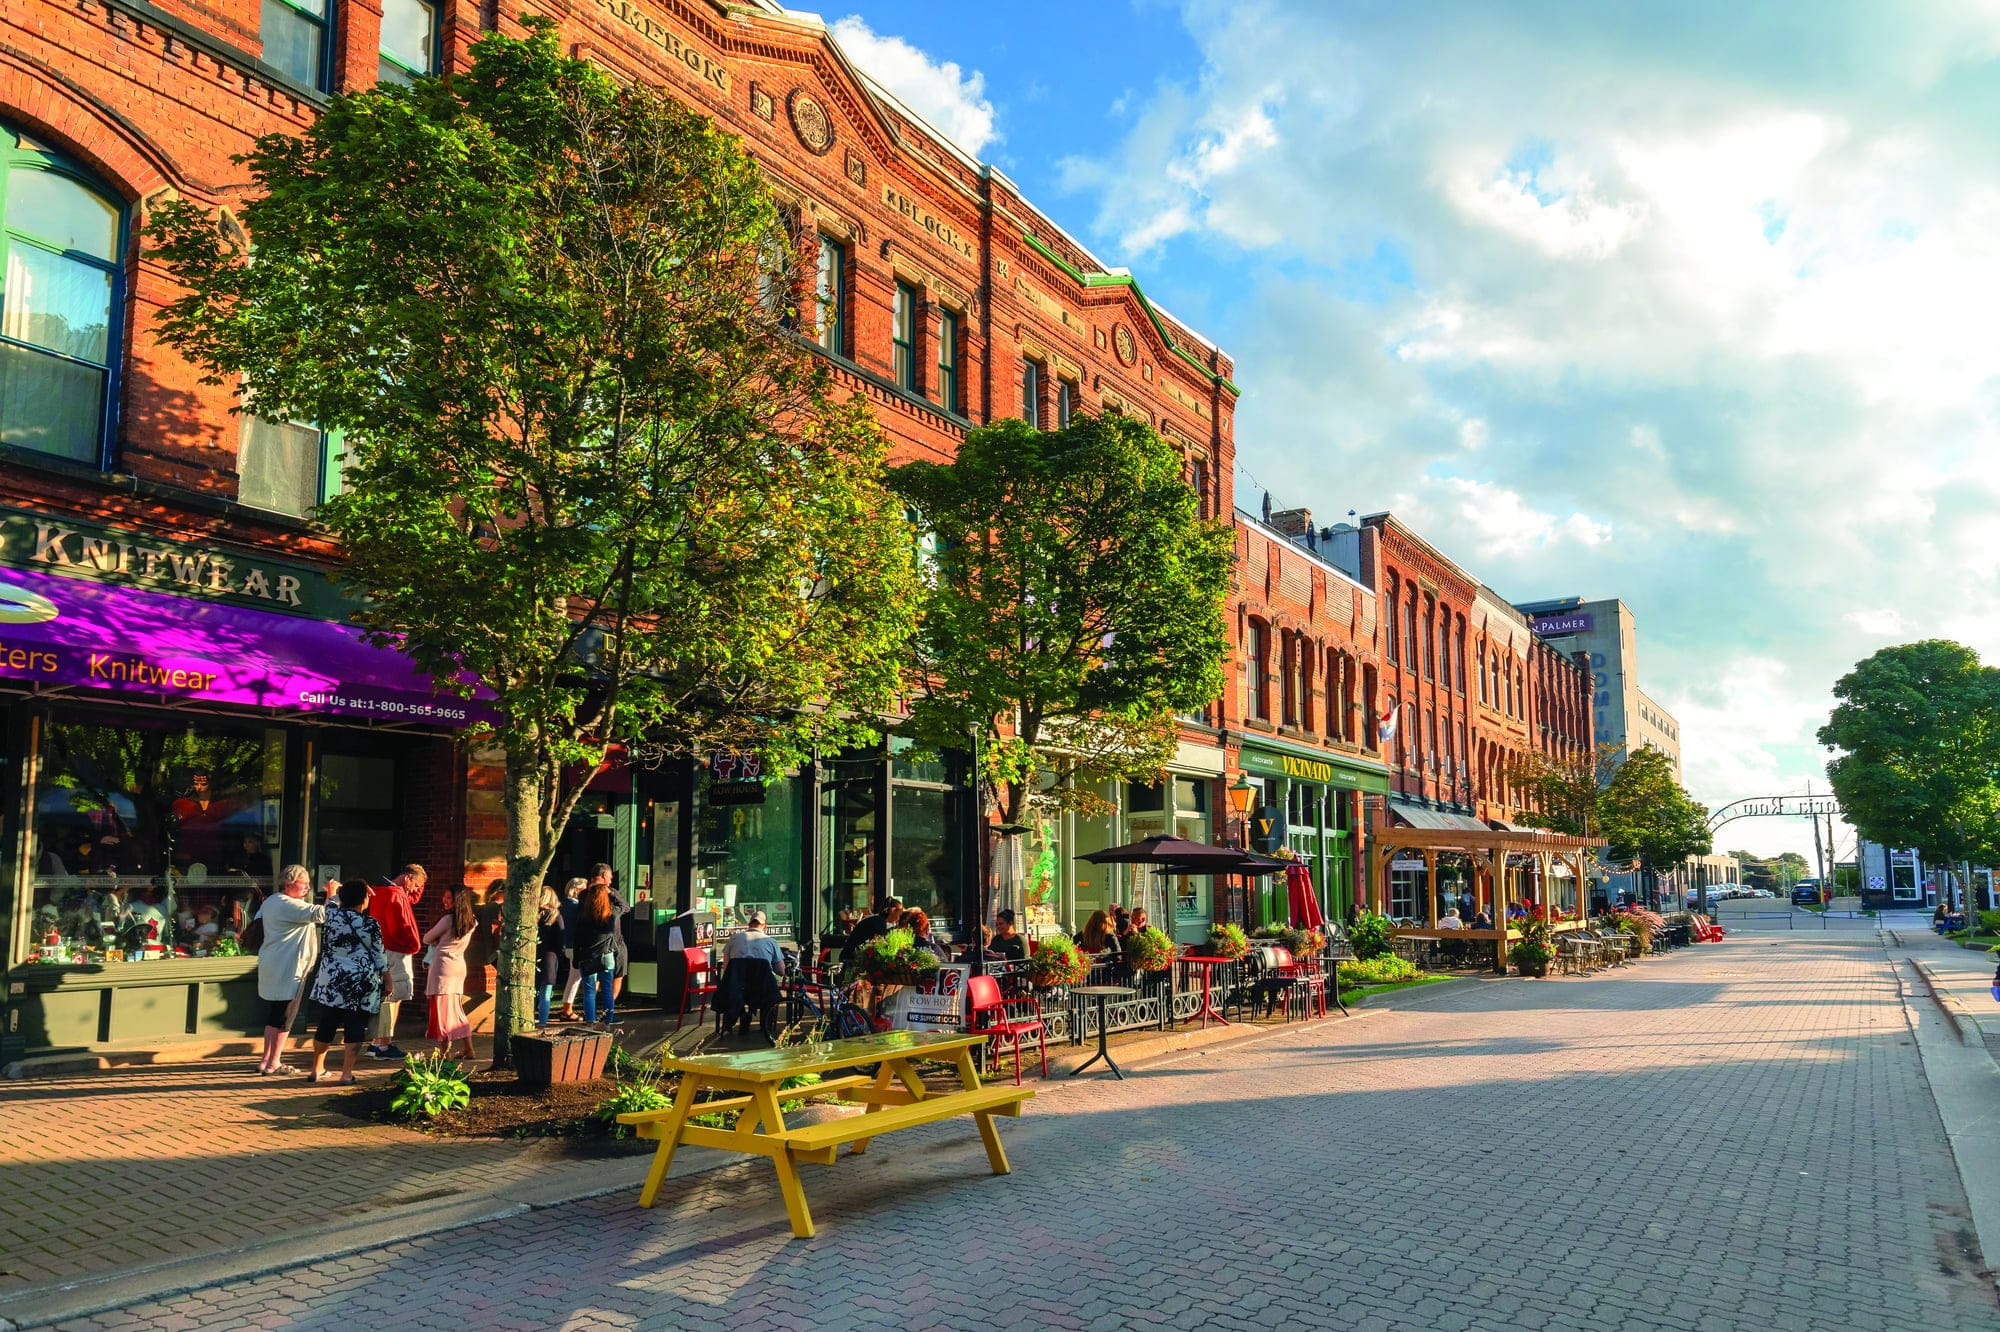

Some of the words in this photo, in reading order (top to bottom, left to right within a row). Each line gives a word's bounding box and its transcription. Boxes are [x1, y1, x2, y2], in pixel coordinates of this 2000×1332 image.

[29, 522, 303, 607] KNITWEAR
[1541, 619, 1586, 632] PALMER
[90, 653, 217, 690] Knitwear
[299, 691, 325, 704] Call
[329, 695, 346, 706] Us
[1282, 755, 1332, 782] VICINATO
[1258, 818, 1275, 836] V
